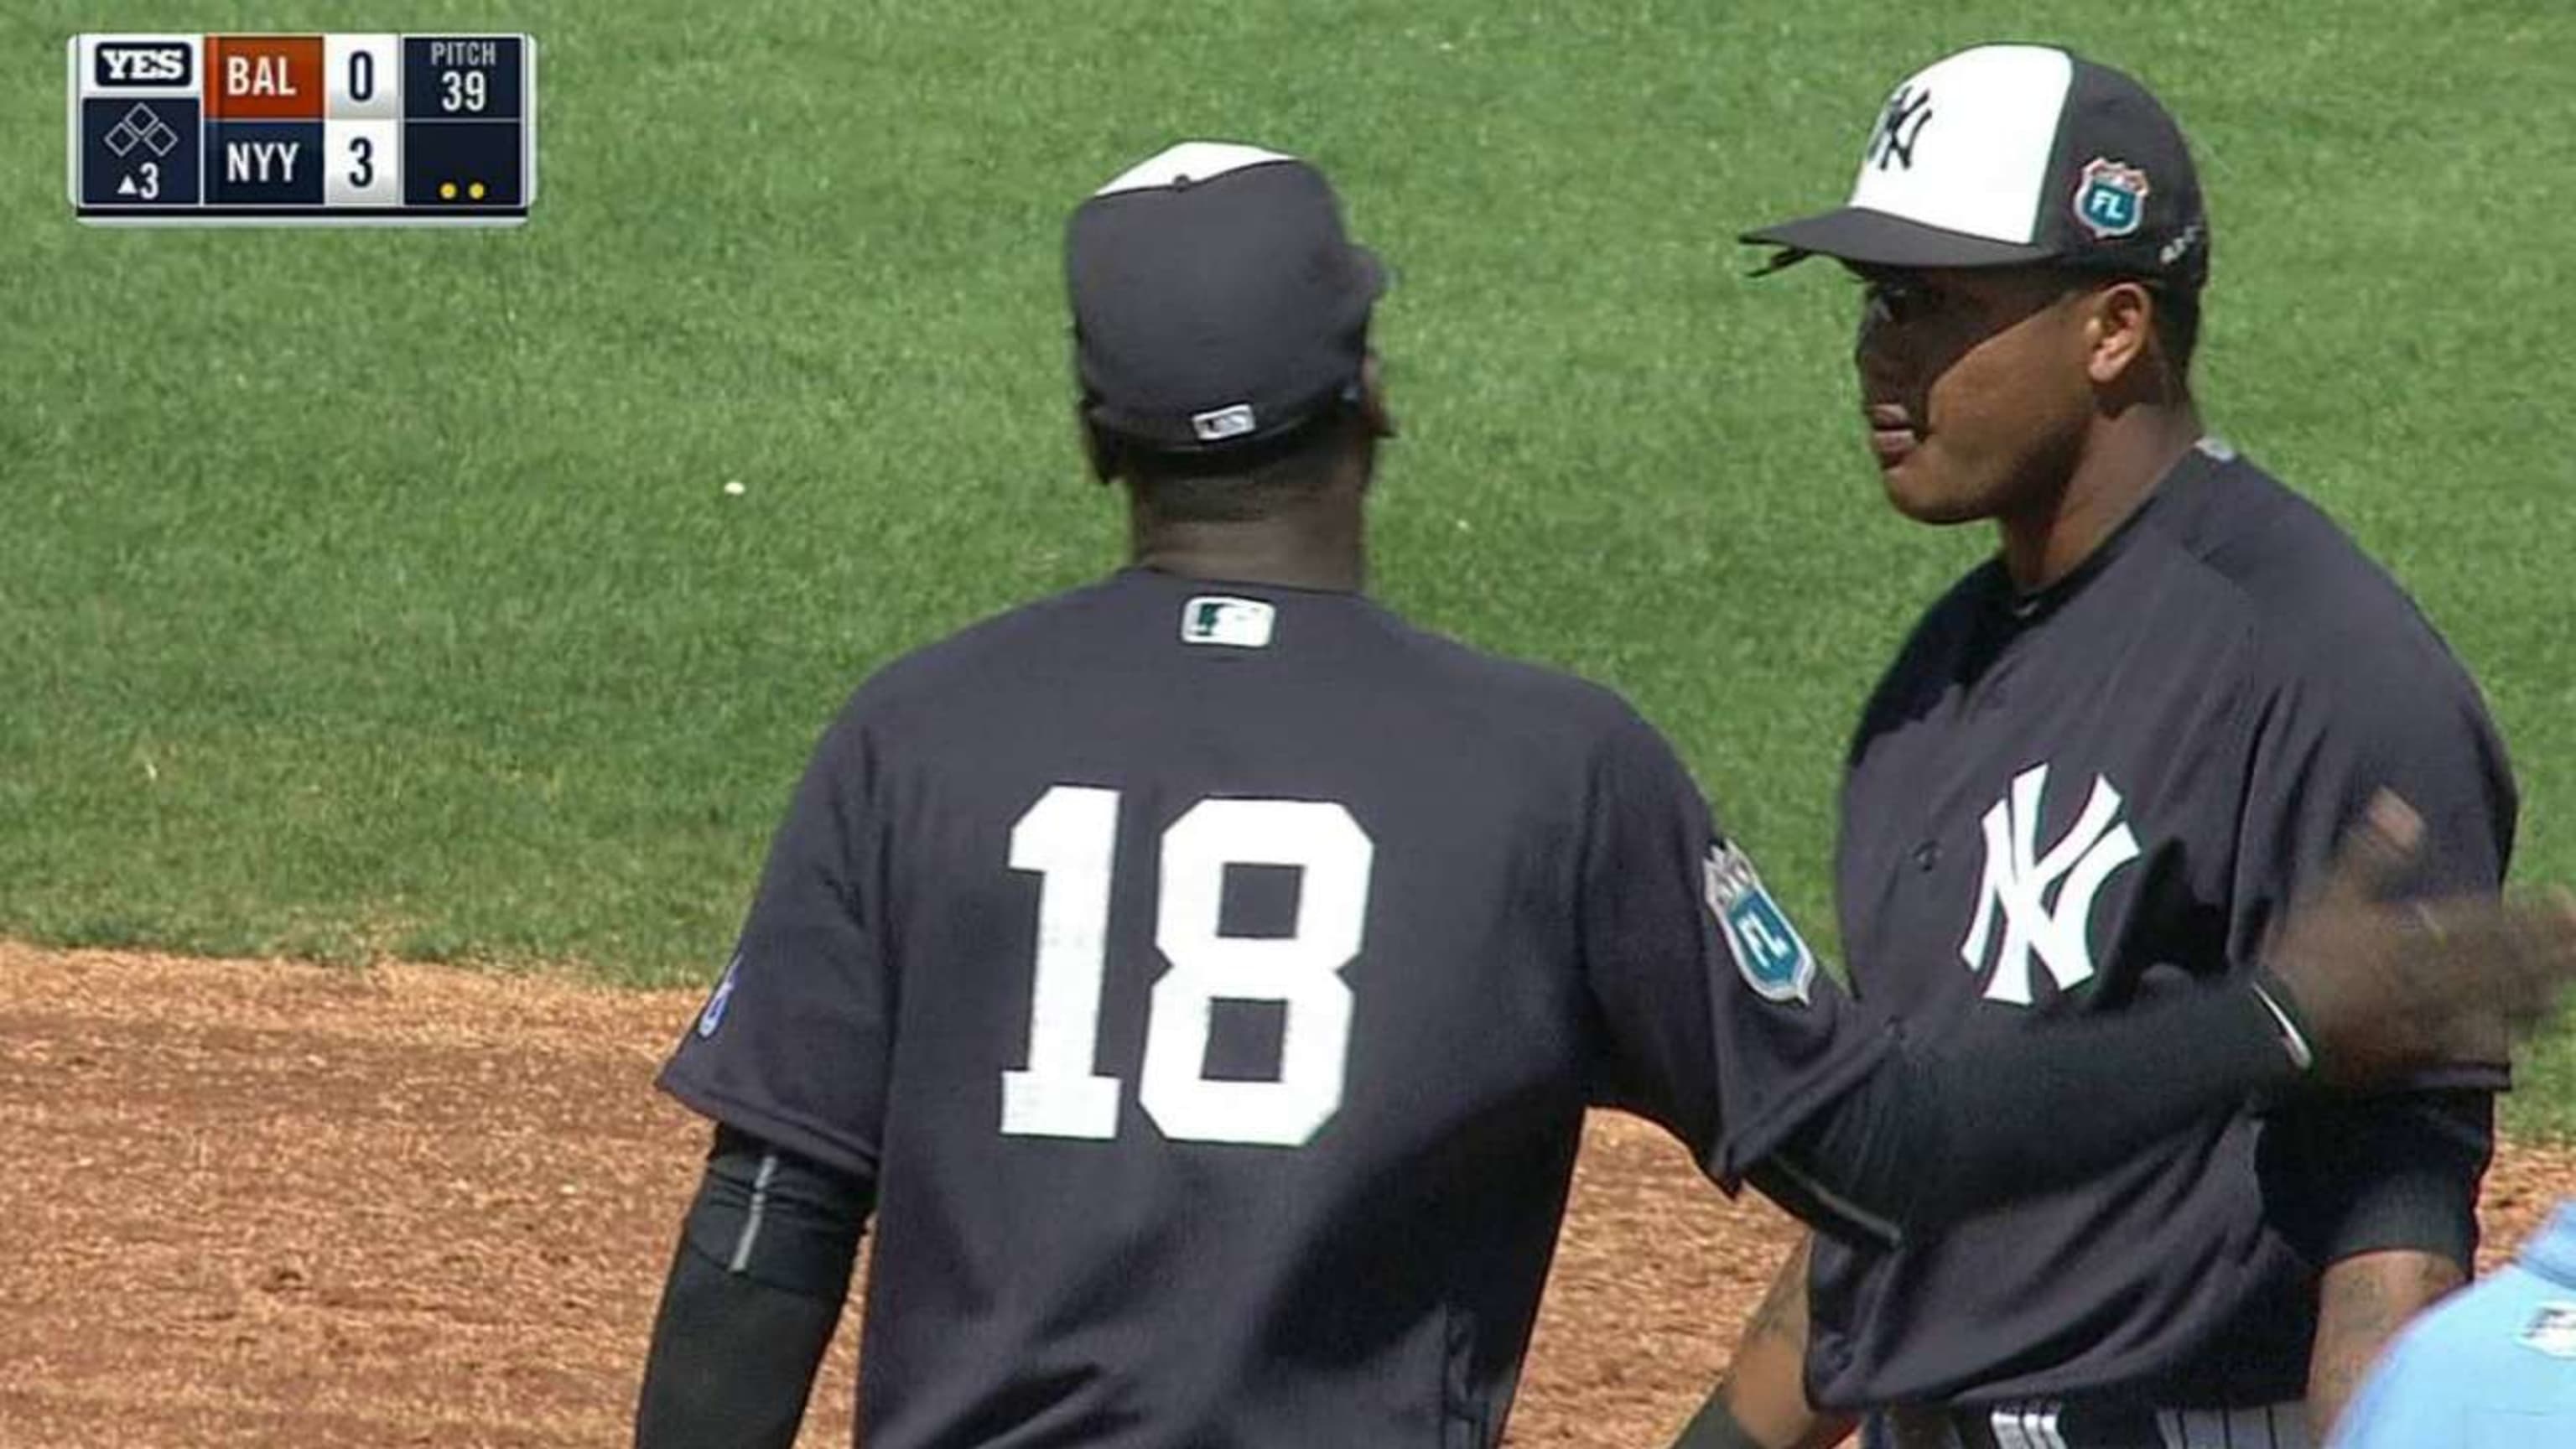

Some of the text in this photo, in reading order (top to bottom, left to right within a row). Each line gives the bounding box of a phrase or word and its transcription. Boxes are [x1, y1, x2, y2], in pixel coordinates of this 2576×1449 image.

[2091, 187, 2126, 221] FL
[1737, 911, 1790, 970] FL
[1960, 763, 2142, 1005] NY
[1000, 785, 1375, 1148] 18
